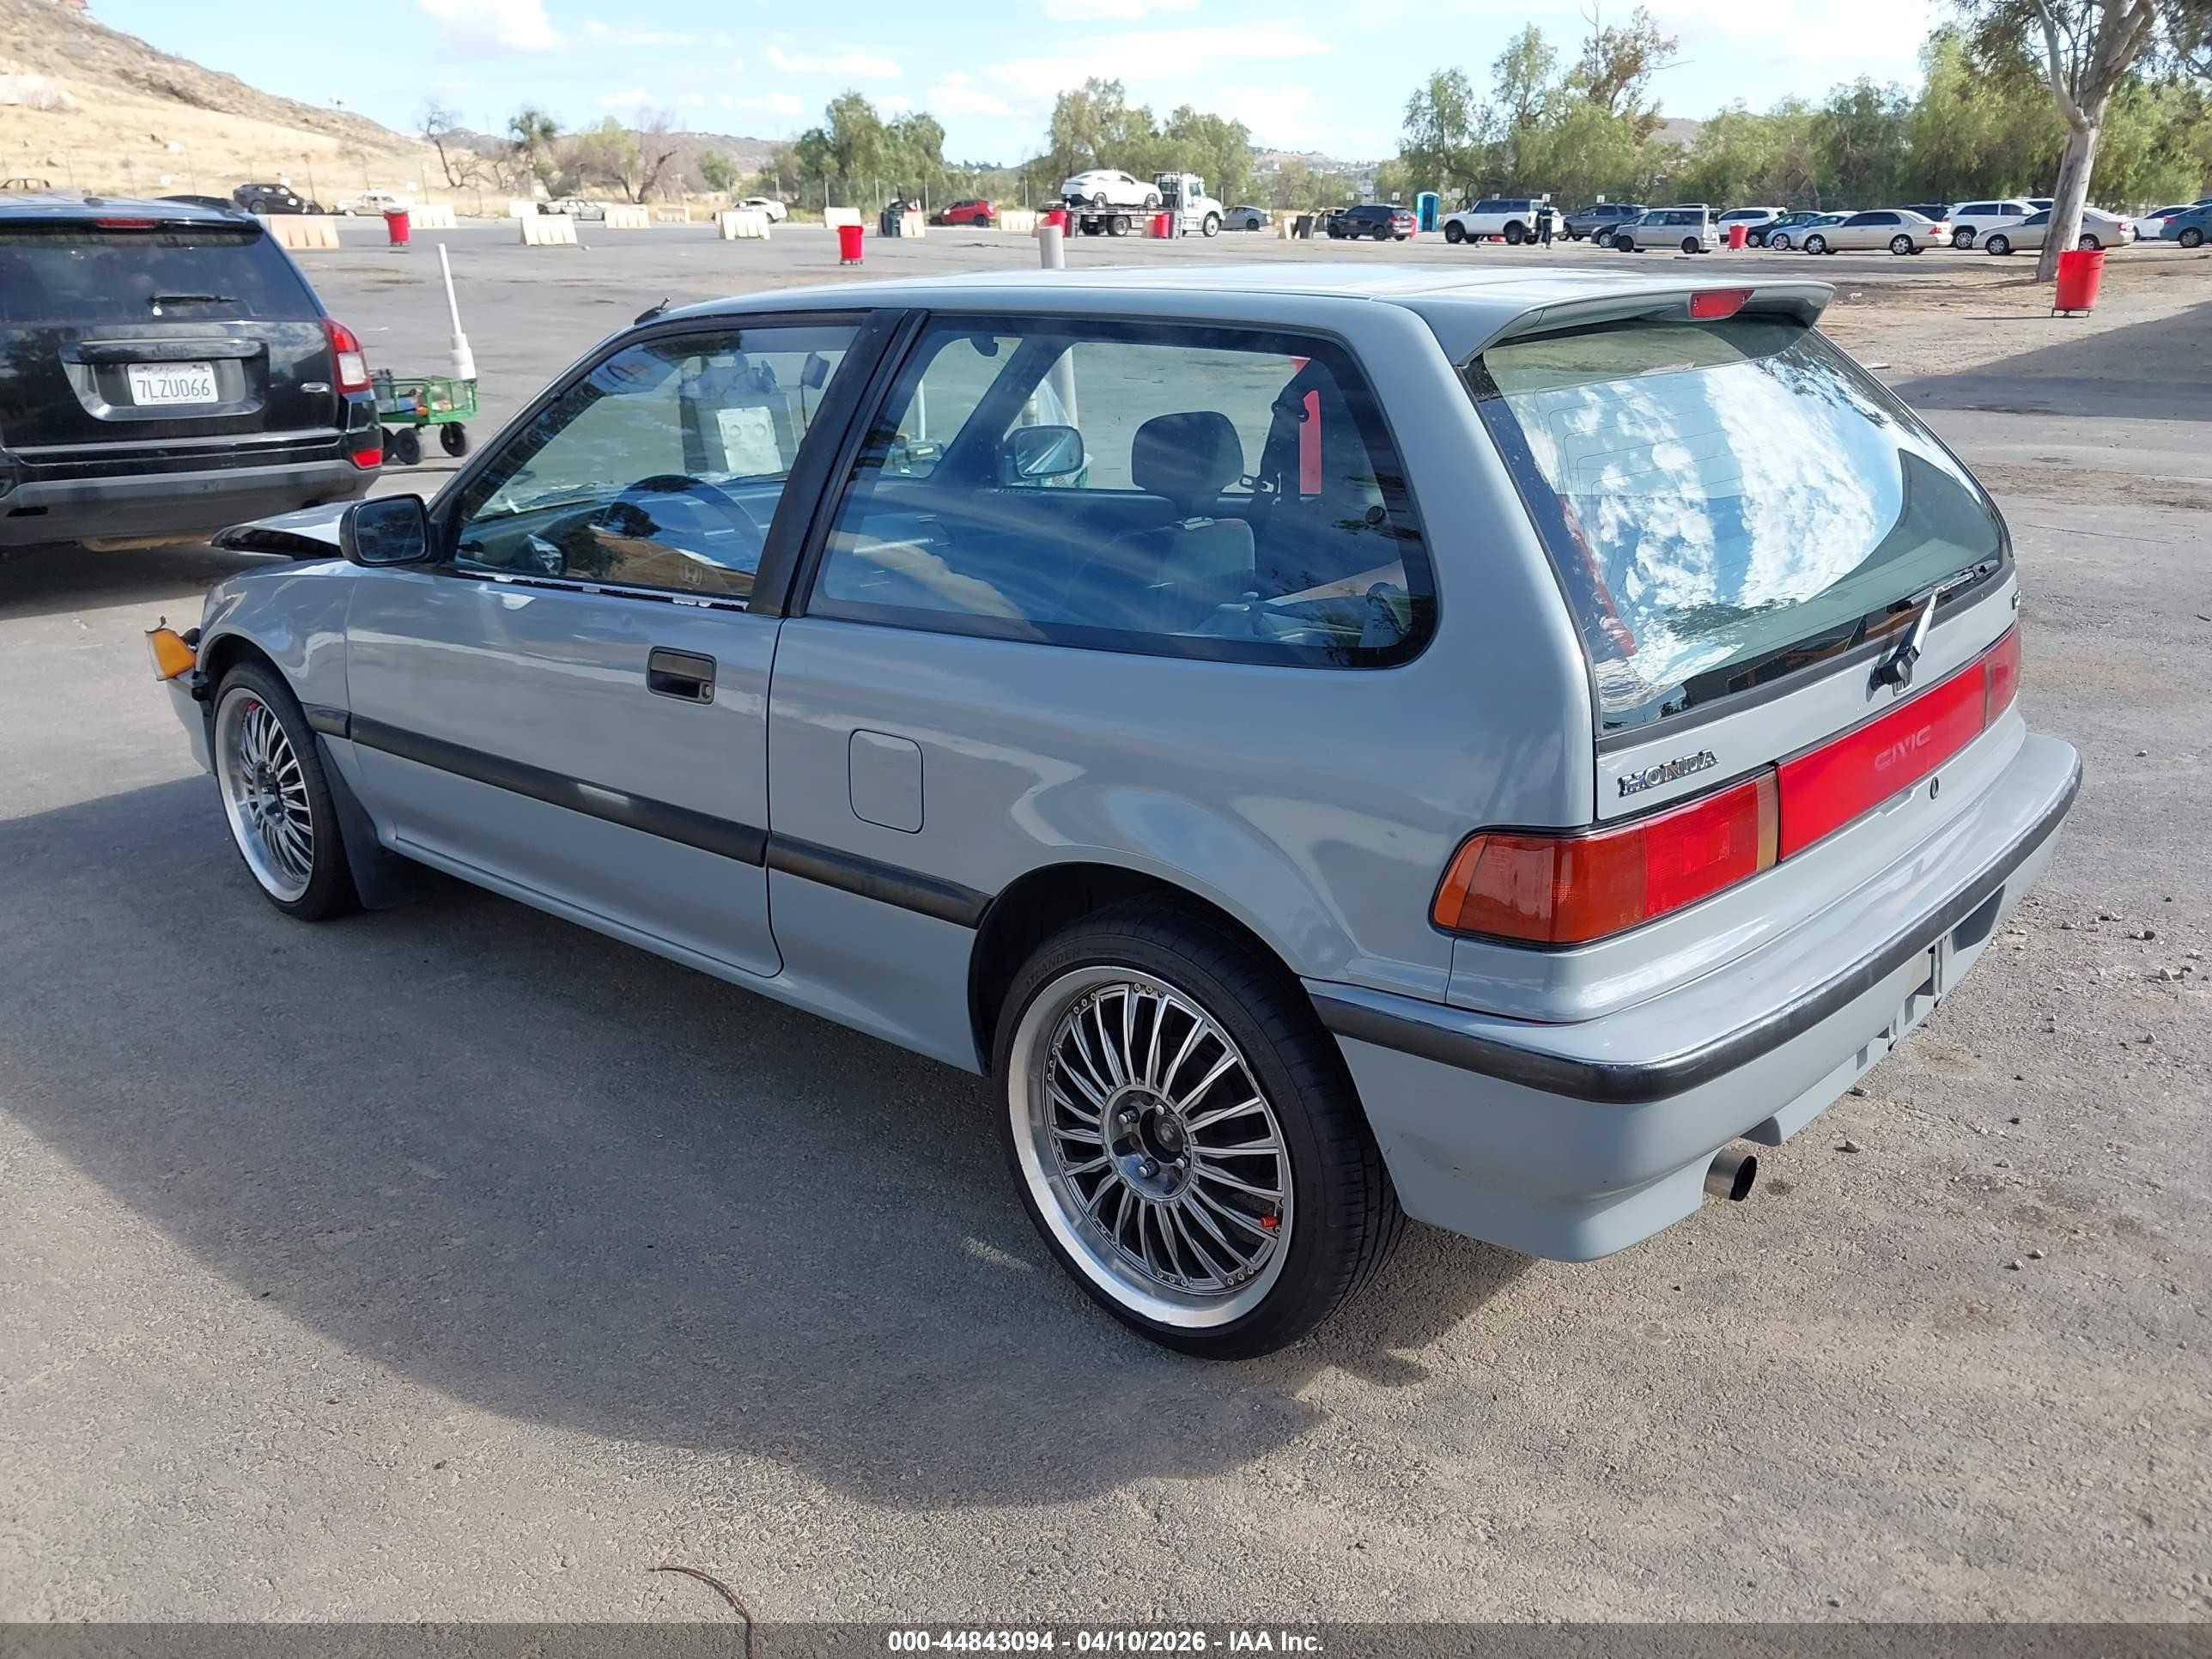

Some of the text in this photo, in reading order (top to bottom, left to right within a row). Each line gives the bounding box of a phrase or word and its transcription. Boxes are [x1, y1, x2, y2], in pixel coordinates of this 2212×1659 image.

[136, 379, 211, 399] 7LZU066
[1617, 744, 1718, 798] HONDA
[1875, 725, 1931, 771] CIVIC
